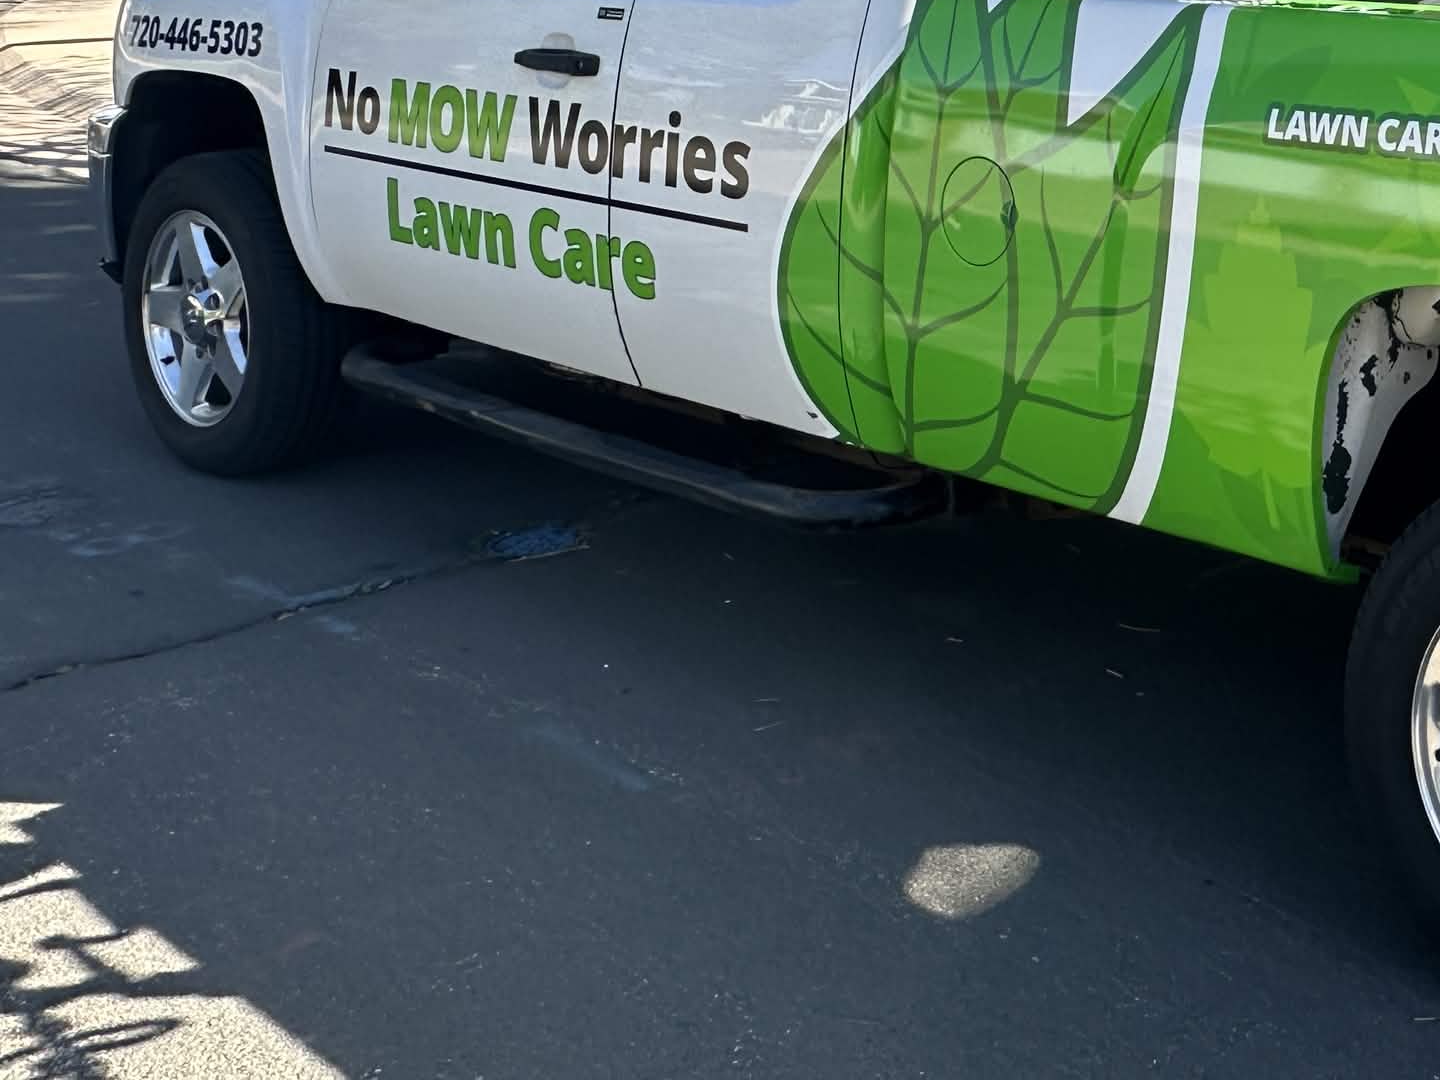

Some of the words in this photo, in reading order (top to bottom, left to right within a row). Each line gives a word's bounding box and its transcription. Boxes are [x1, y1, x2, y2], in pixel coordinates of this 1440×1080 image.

[130, 14, 264, 57] 720-446-5303
[324, 67, 380, 136] No
[388, 77, 518, 163] MOW
[529, 95, 752, 199] Worries
[1267, 107, 1369, 149] LAWN
[386, 176, 517, 269] Lawn
[529, 206, 657, 300] Care
